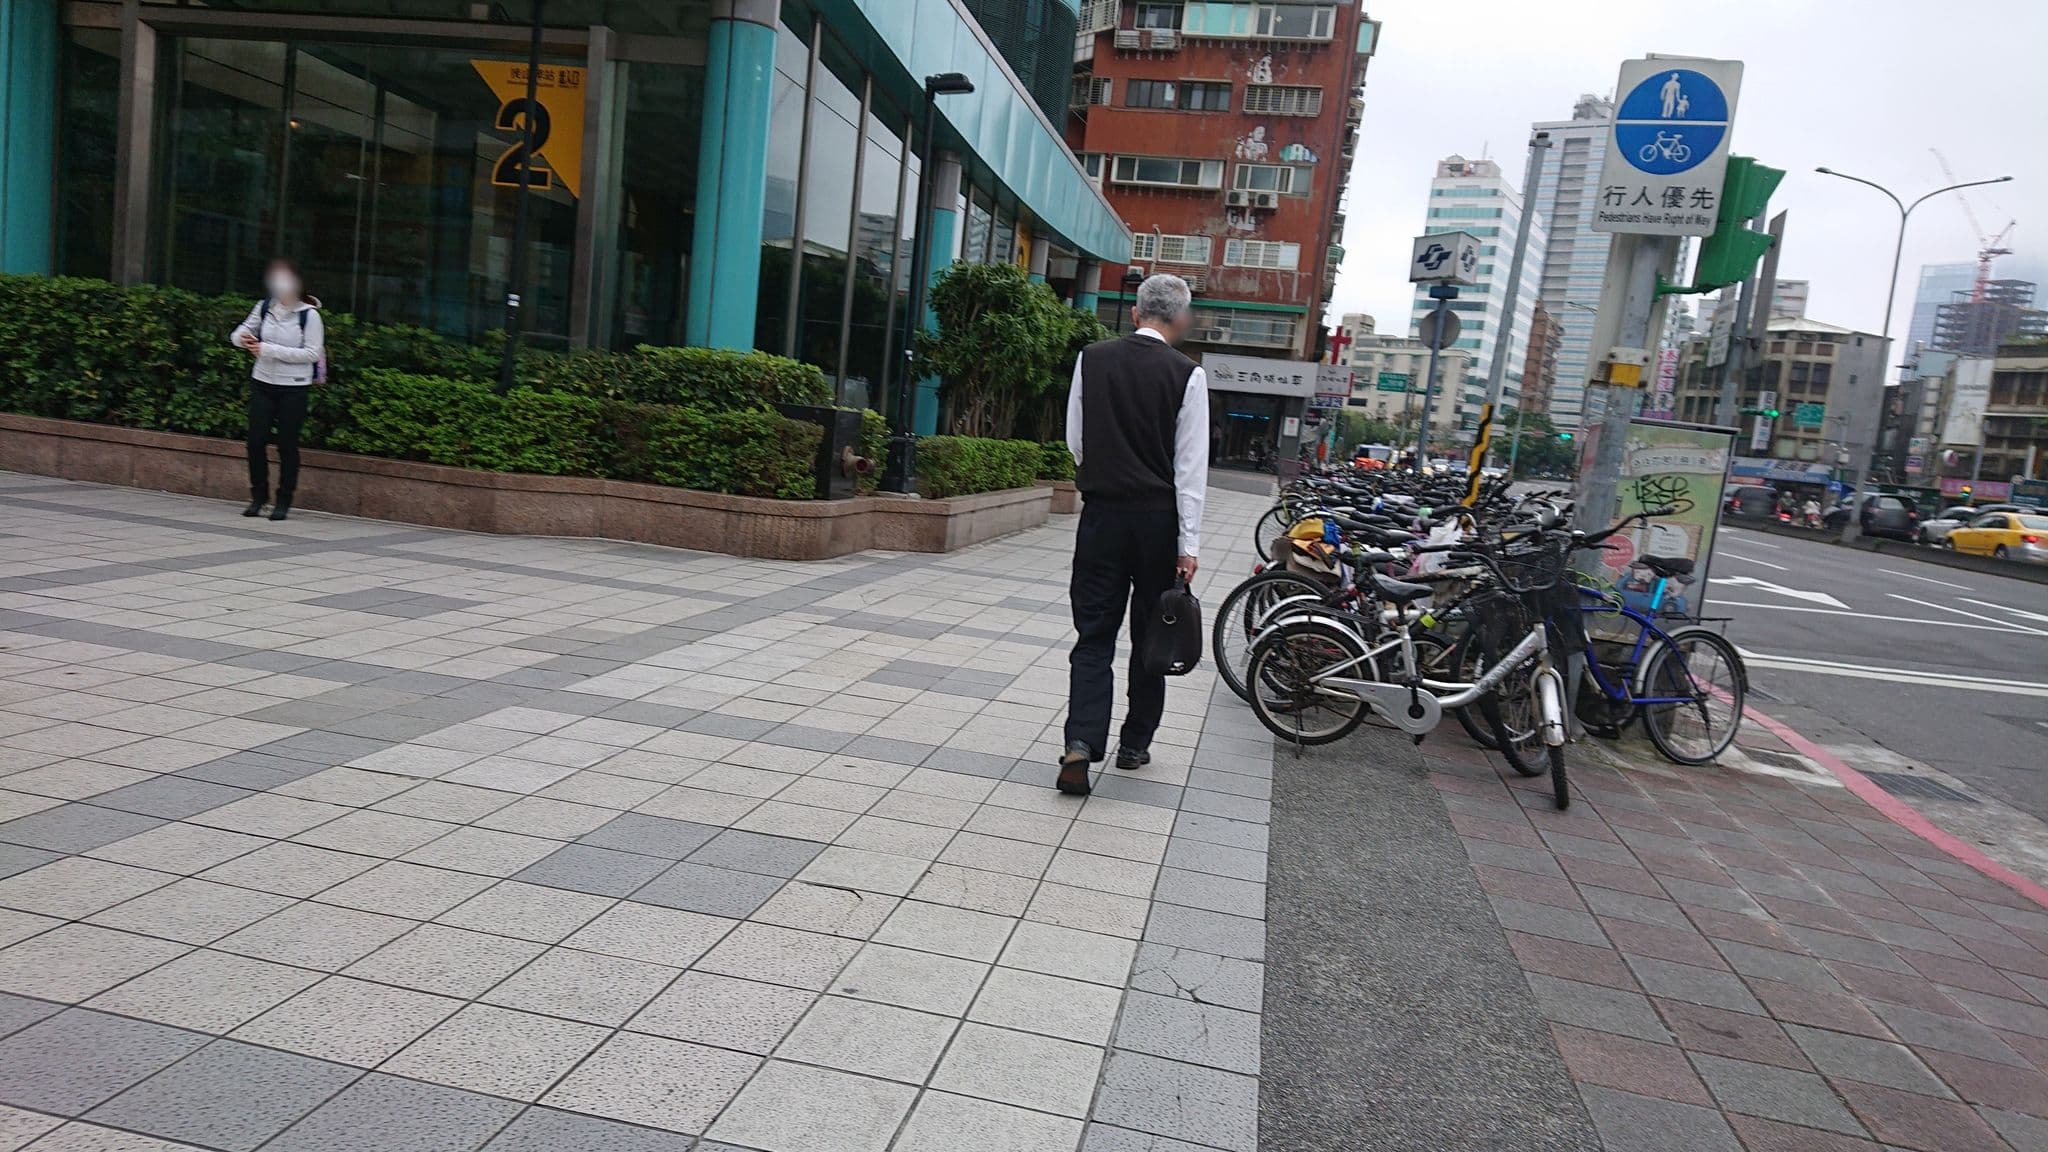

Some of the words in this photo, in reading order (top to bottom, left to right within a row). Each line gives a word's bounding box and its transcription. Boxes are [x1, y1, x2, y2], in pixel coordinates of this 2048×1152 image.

[491, 97, 552, 190] 2
[1602, 185, 1715, 210] 行人優先
[1599, 211, 1642, 223] Pedestrians
[1643, 213, 1662, 224] Have
[1664, 213, 1684, 227] Right
[1685, 215, 1693, 224] of
[1694, 214, 1711, 228] Way
